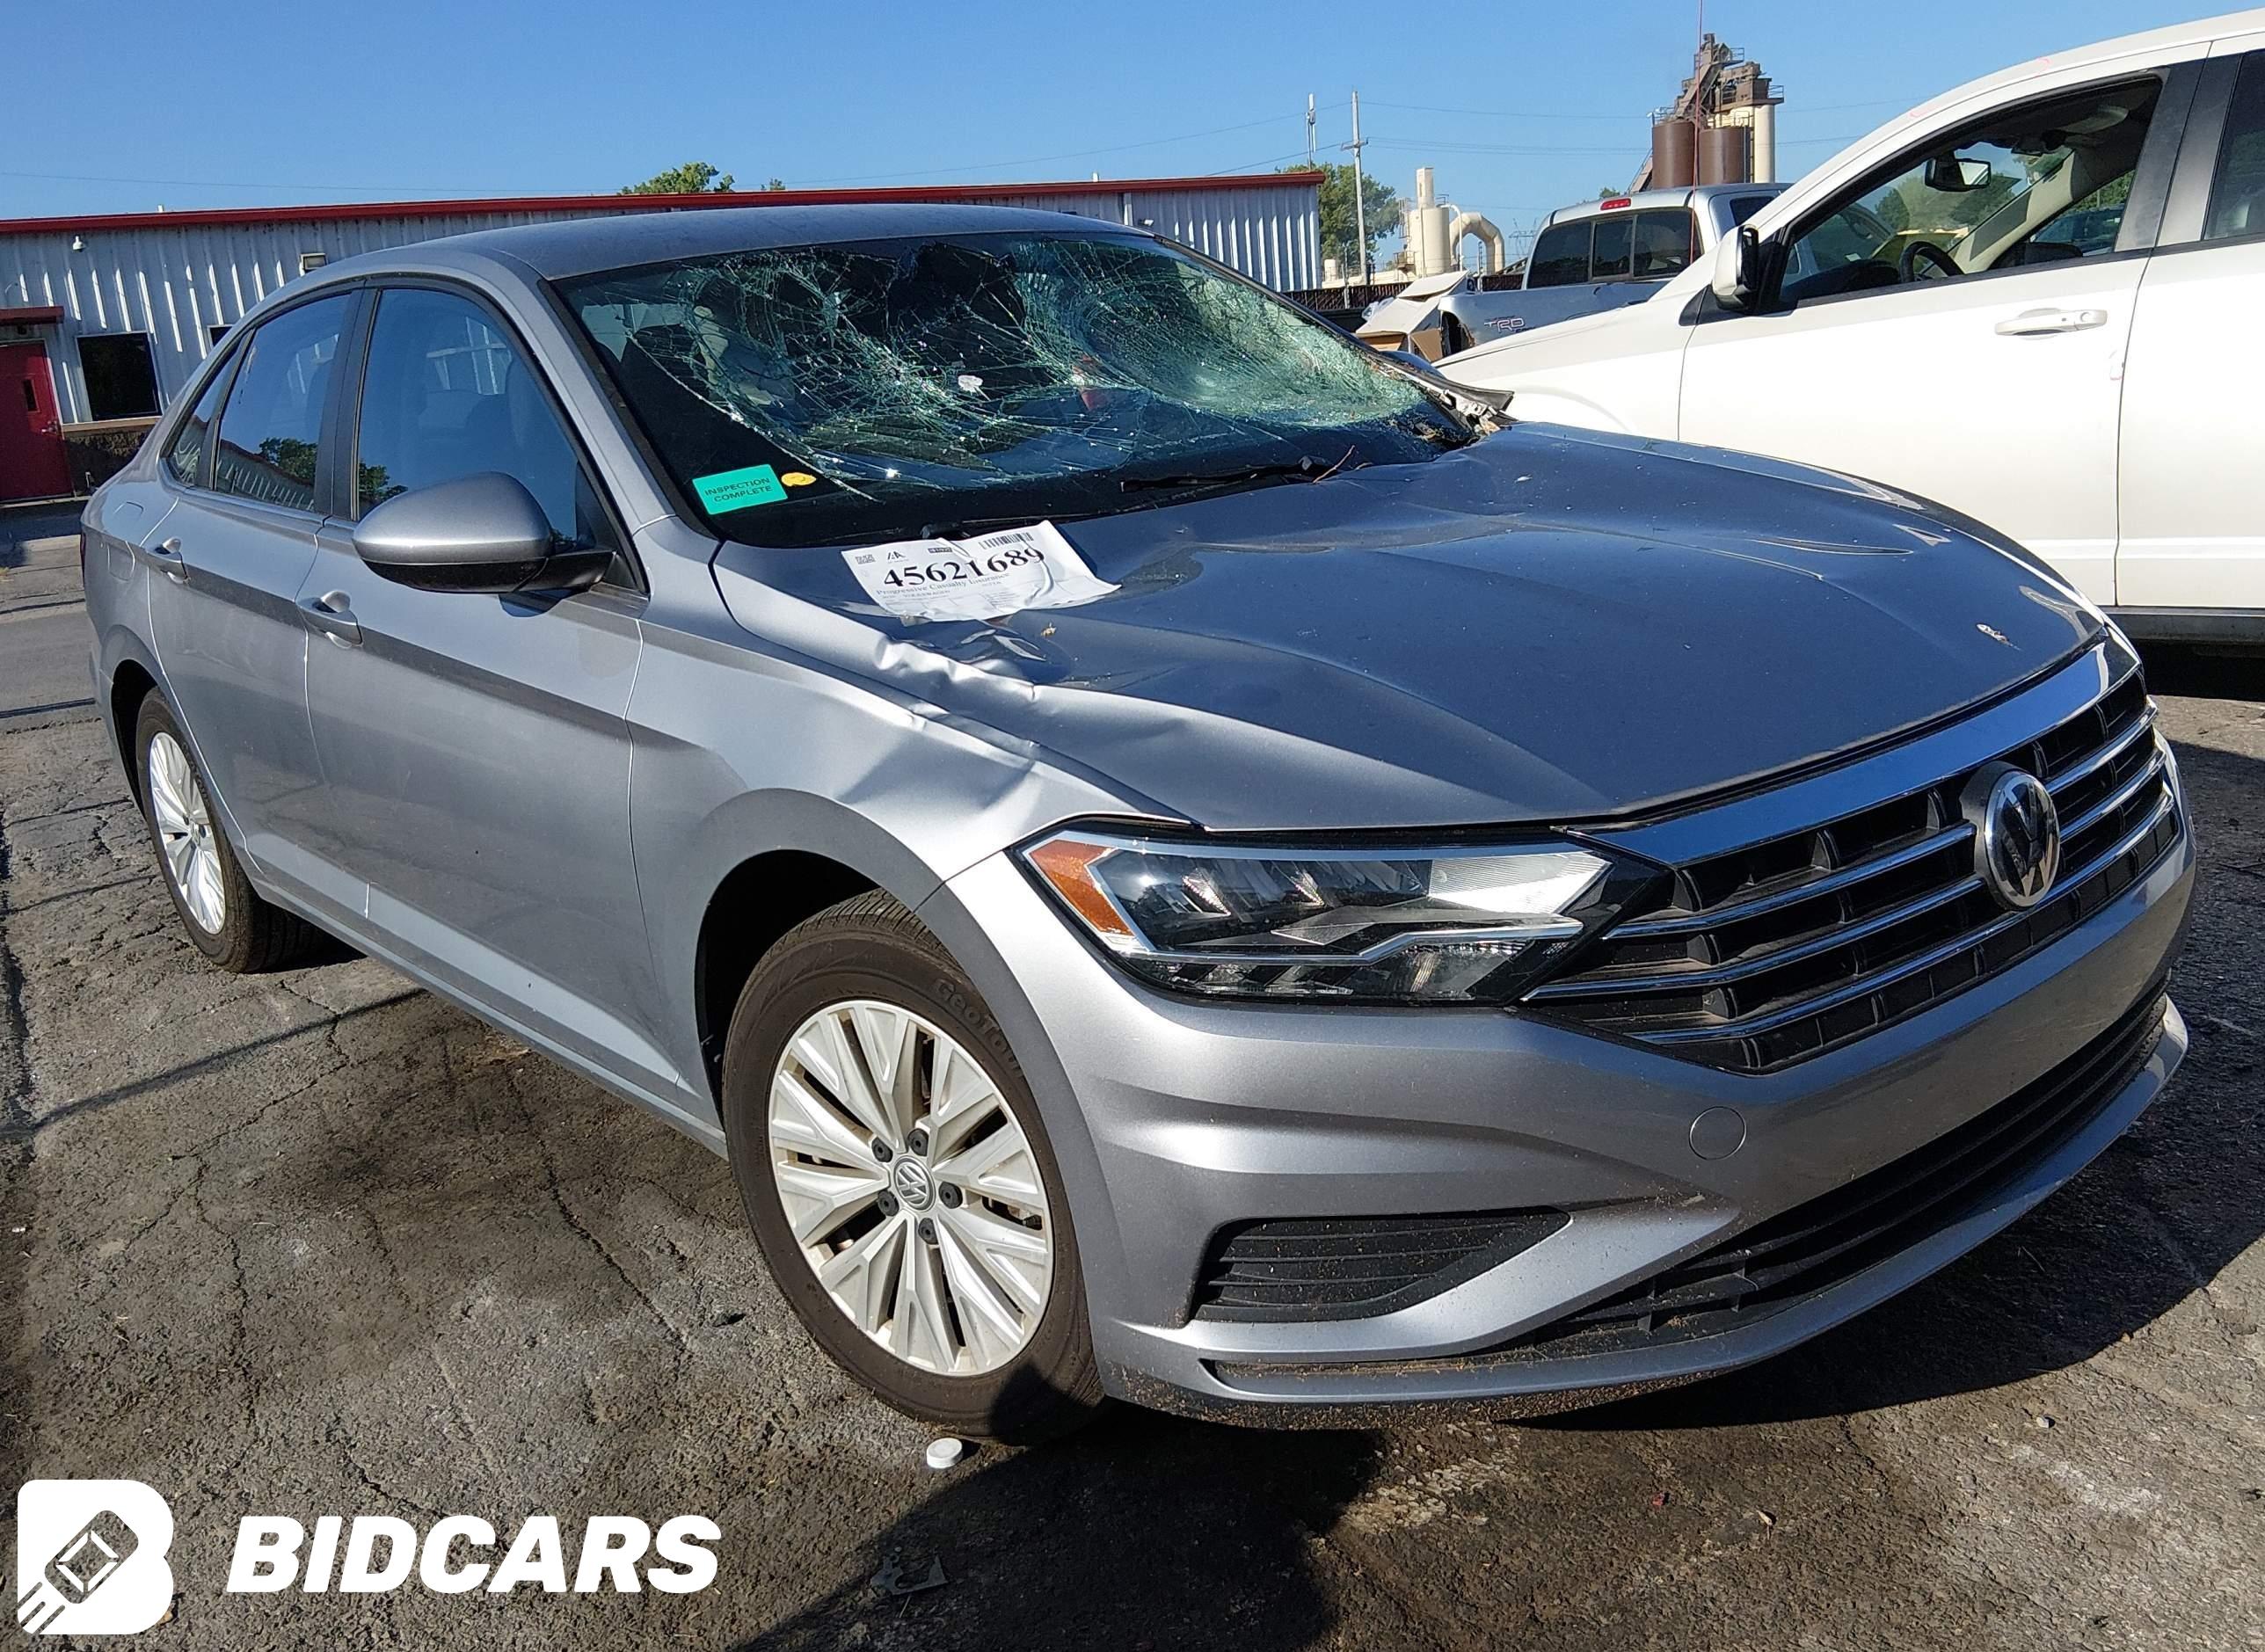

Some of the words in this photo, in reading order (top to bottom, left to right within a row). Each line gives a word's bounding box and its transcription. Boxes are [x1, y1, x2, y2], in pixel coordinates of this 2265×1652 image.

[1484, 317, 1525, 332] TRD
[705, 477, 770, 496] INSPECTION
[714, 485, 774, 503] COMPLETE
[884, 548, 1045, 586] 45621689
